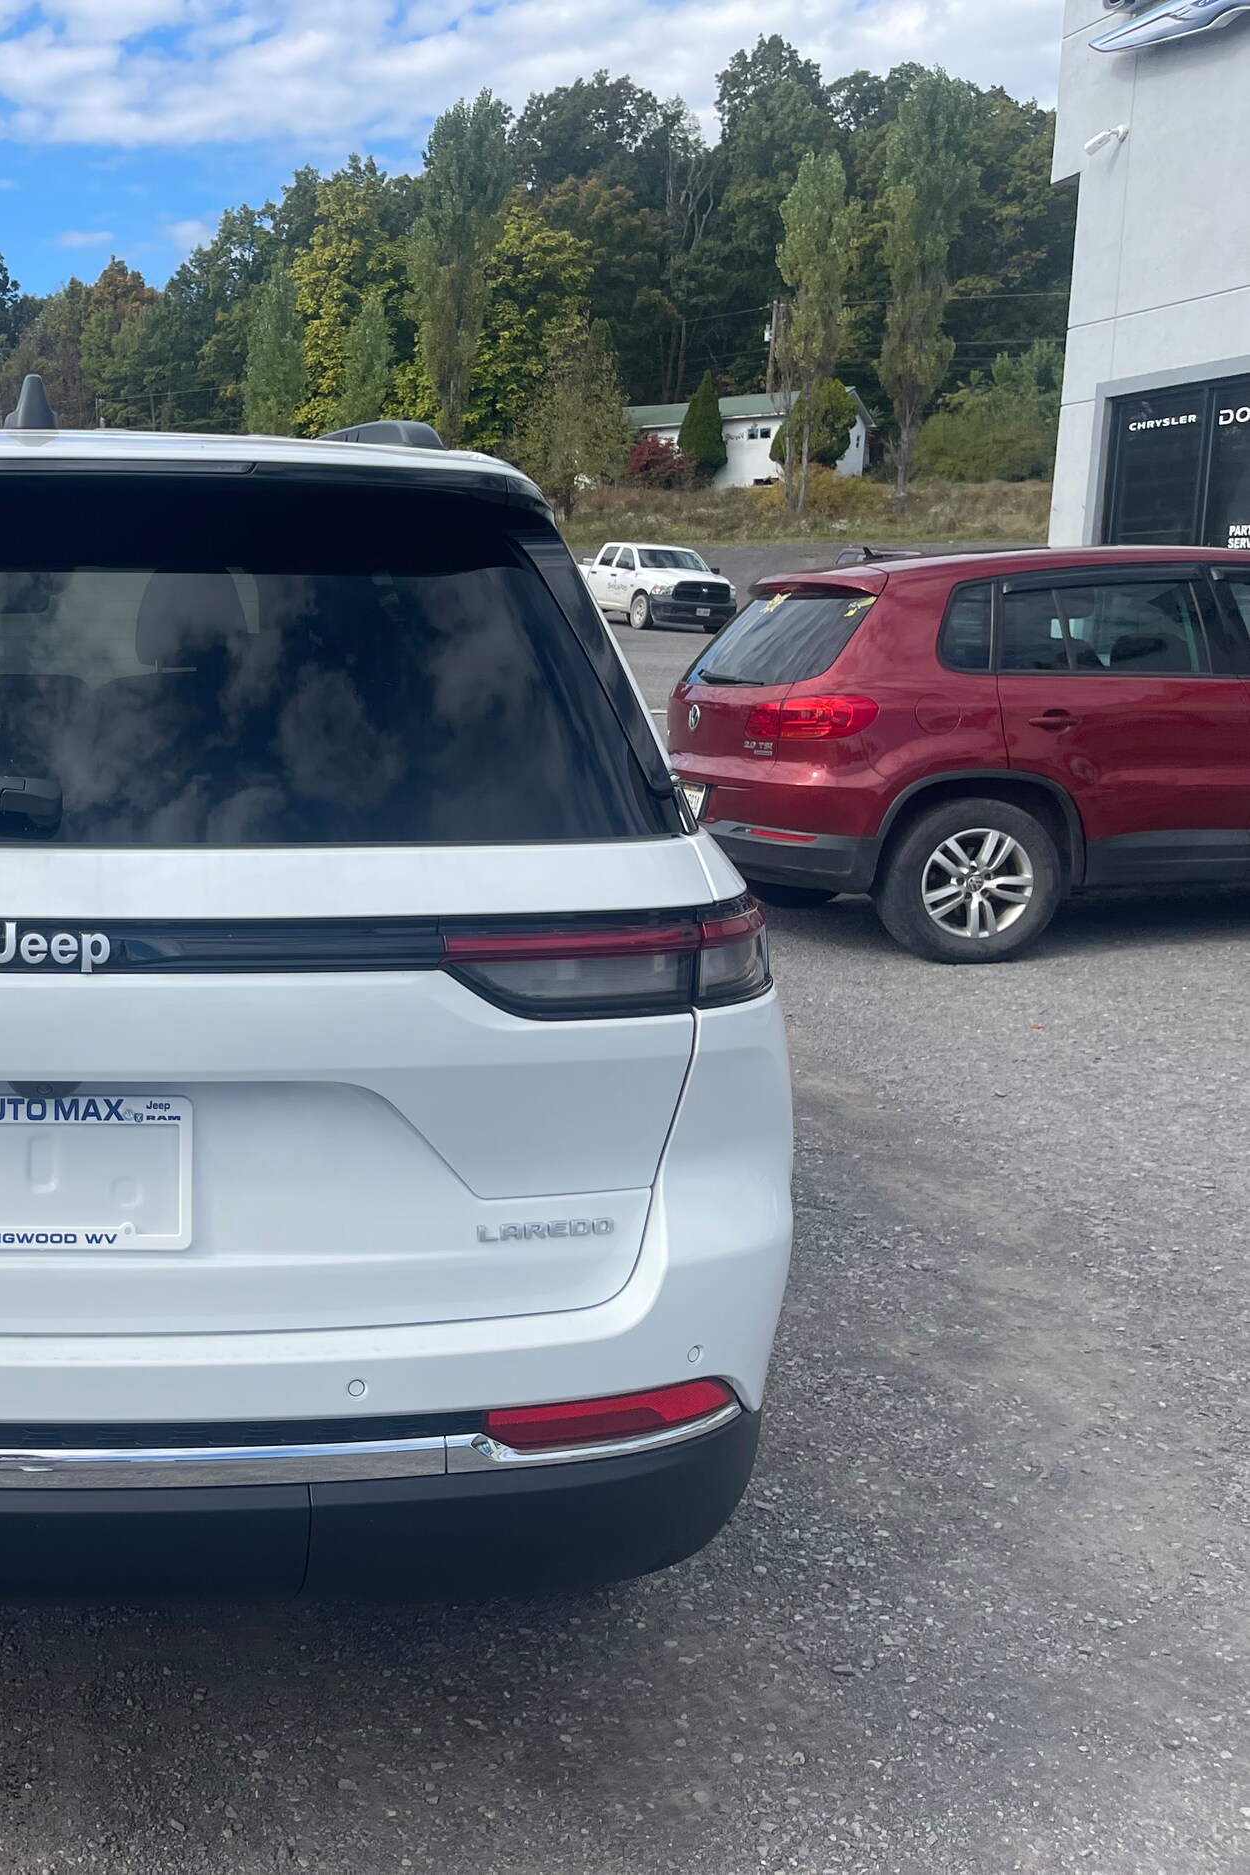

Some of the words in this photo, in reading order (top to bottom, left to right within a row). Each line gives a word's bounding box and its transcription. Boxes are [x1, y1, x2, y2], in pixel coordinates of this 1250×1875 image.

[1128, 414, 1197, 432] CHRYSLER
[54, 1098, 124, 1121] MAX
[146, 1100, 171, 1112] Jeep
[84, 1233, 118, 1244] WV
[476, 1216, 615, 1243] LAREDO
